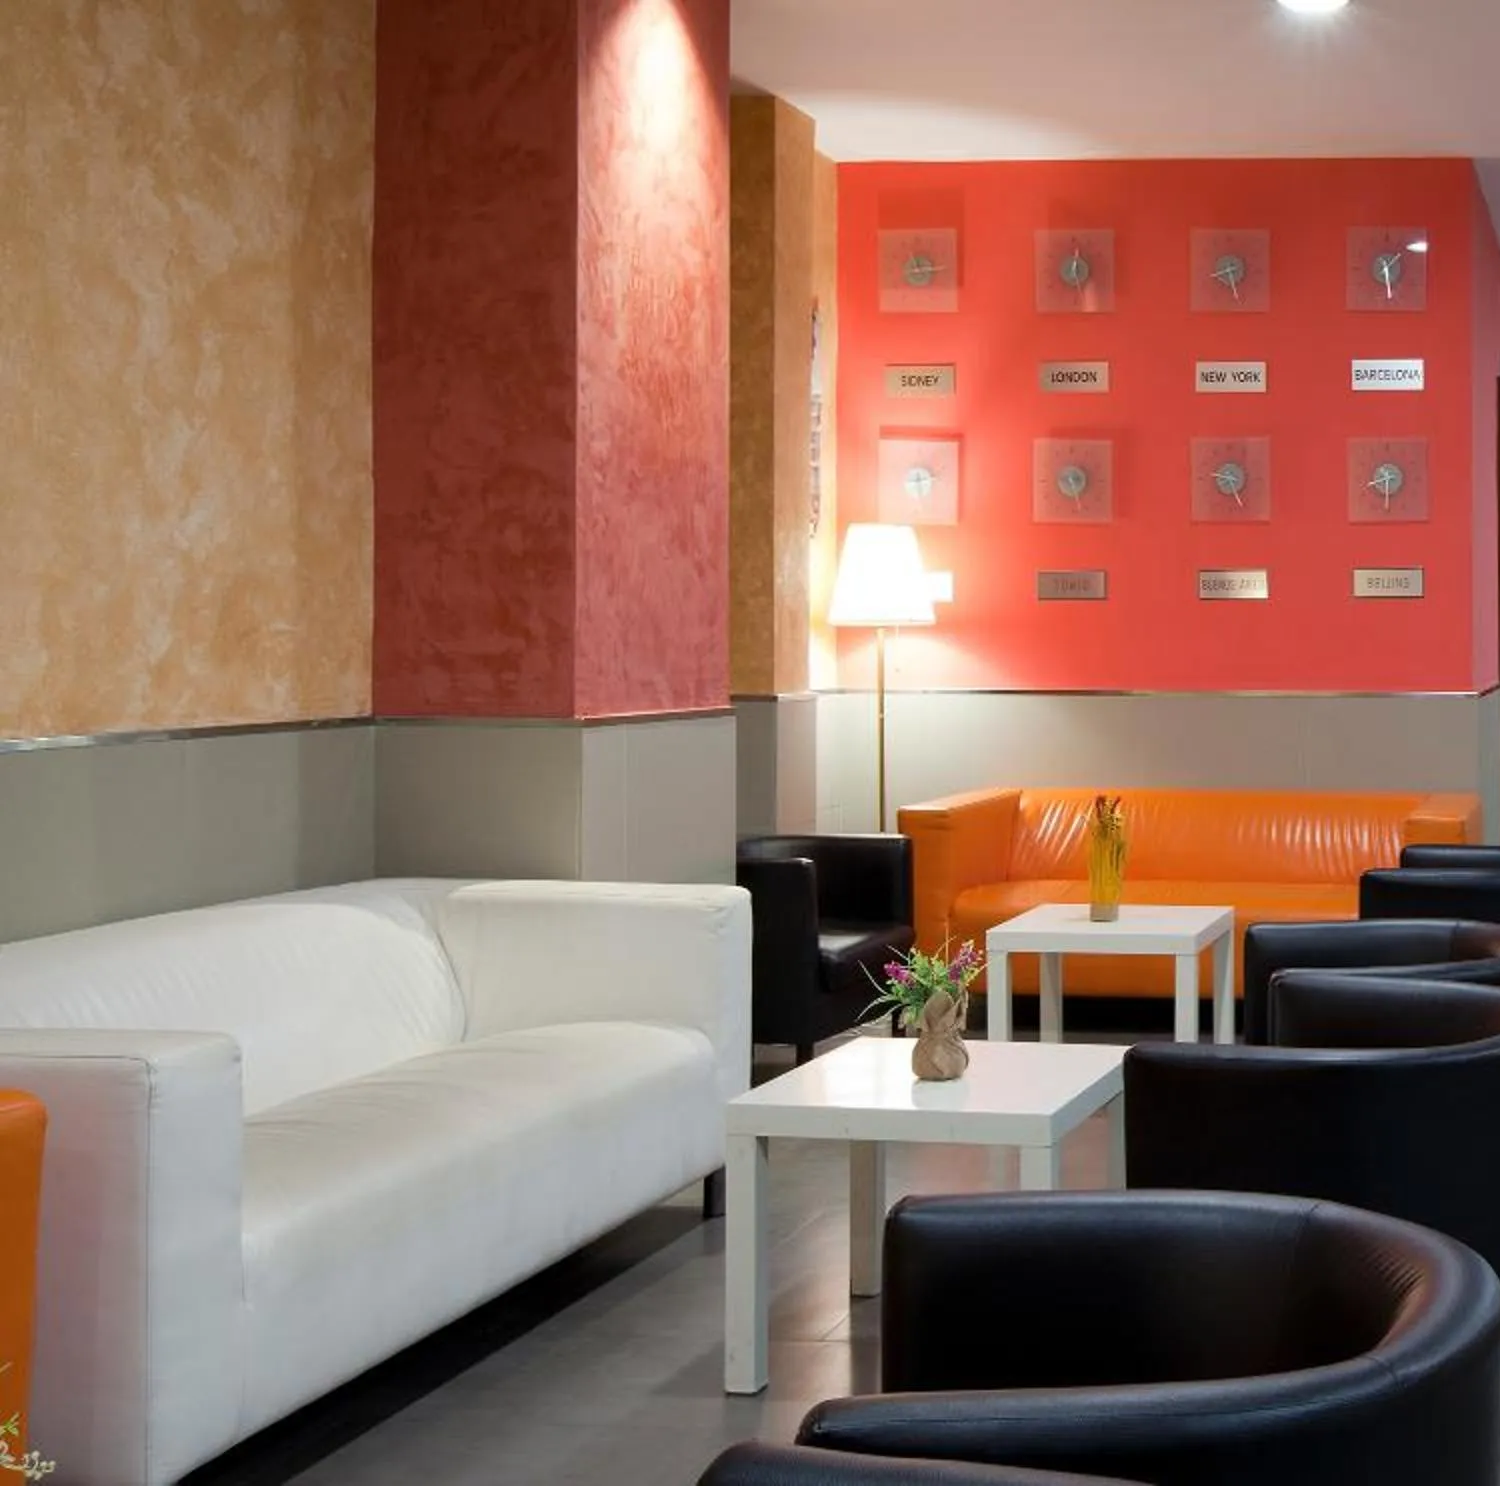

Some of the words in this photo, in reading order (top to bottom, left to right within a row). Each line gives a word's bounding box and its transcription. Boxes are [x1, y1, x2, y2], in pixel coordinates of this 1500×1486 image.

[902, 374, 940, 387] SIDNEY
[1051, 371, 1098, 383] LONDON
[1201, 371, 1227, 383] NEW
[1231, 371, 1262, 383] YORK
[1355, 369, 1421, 381] BARCELONA
